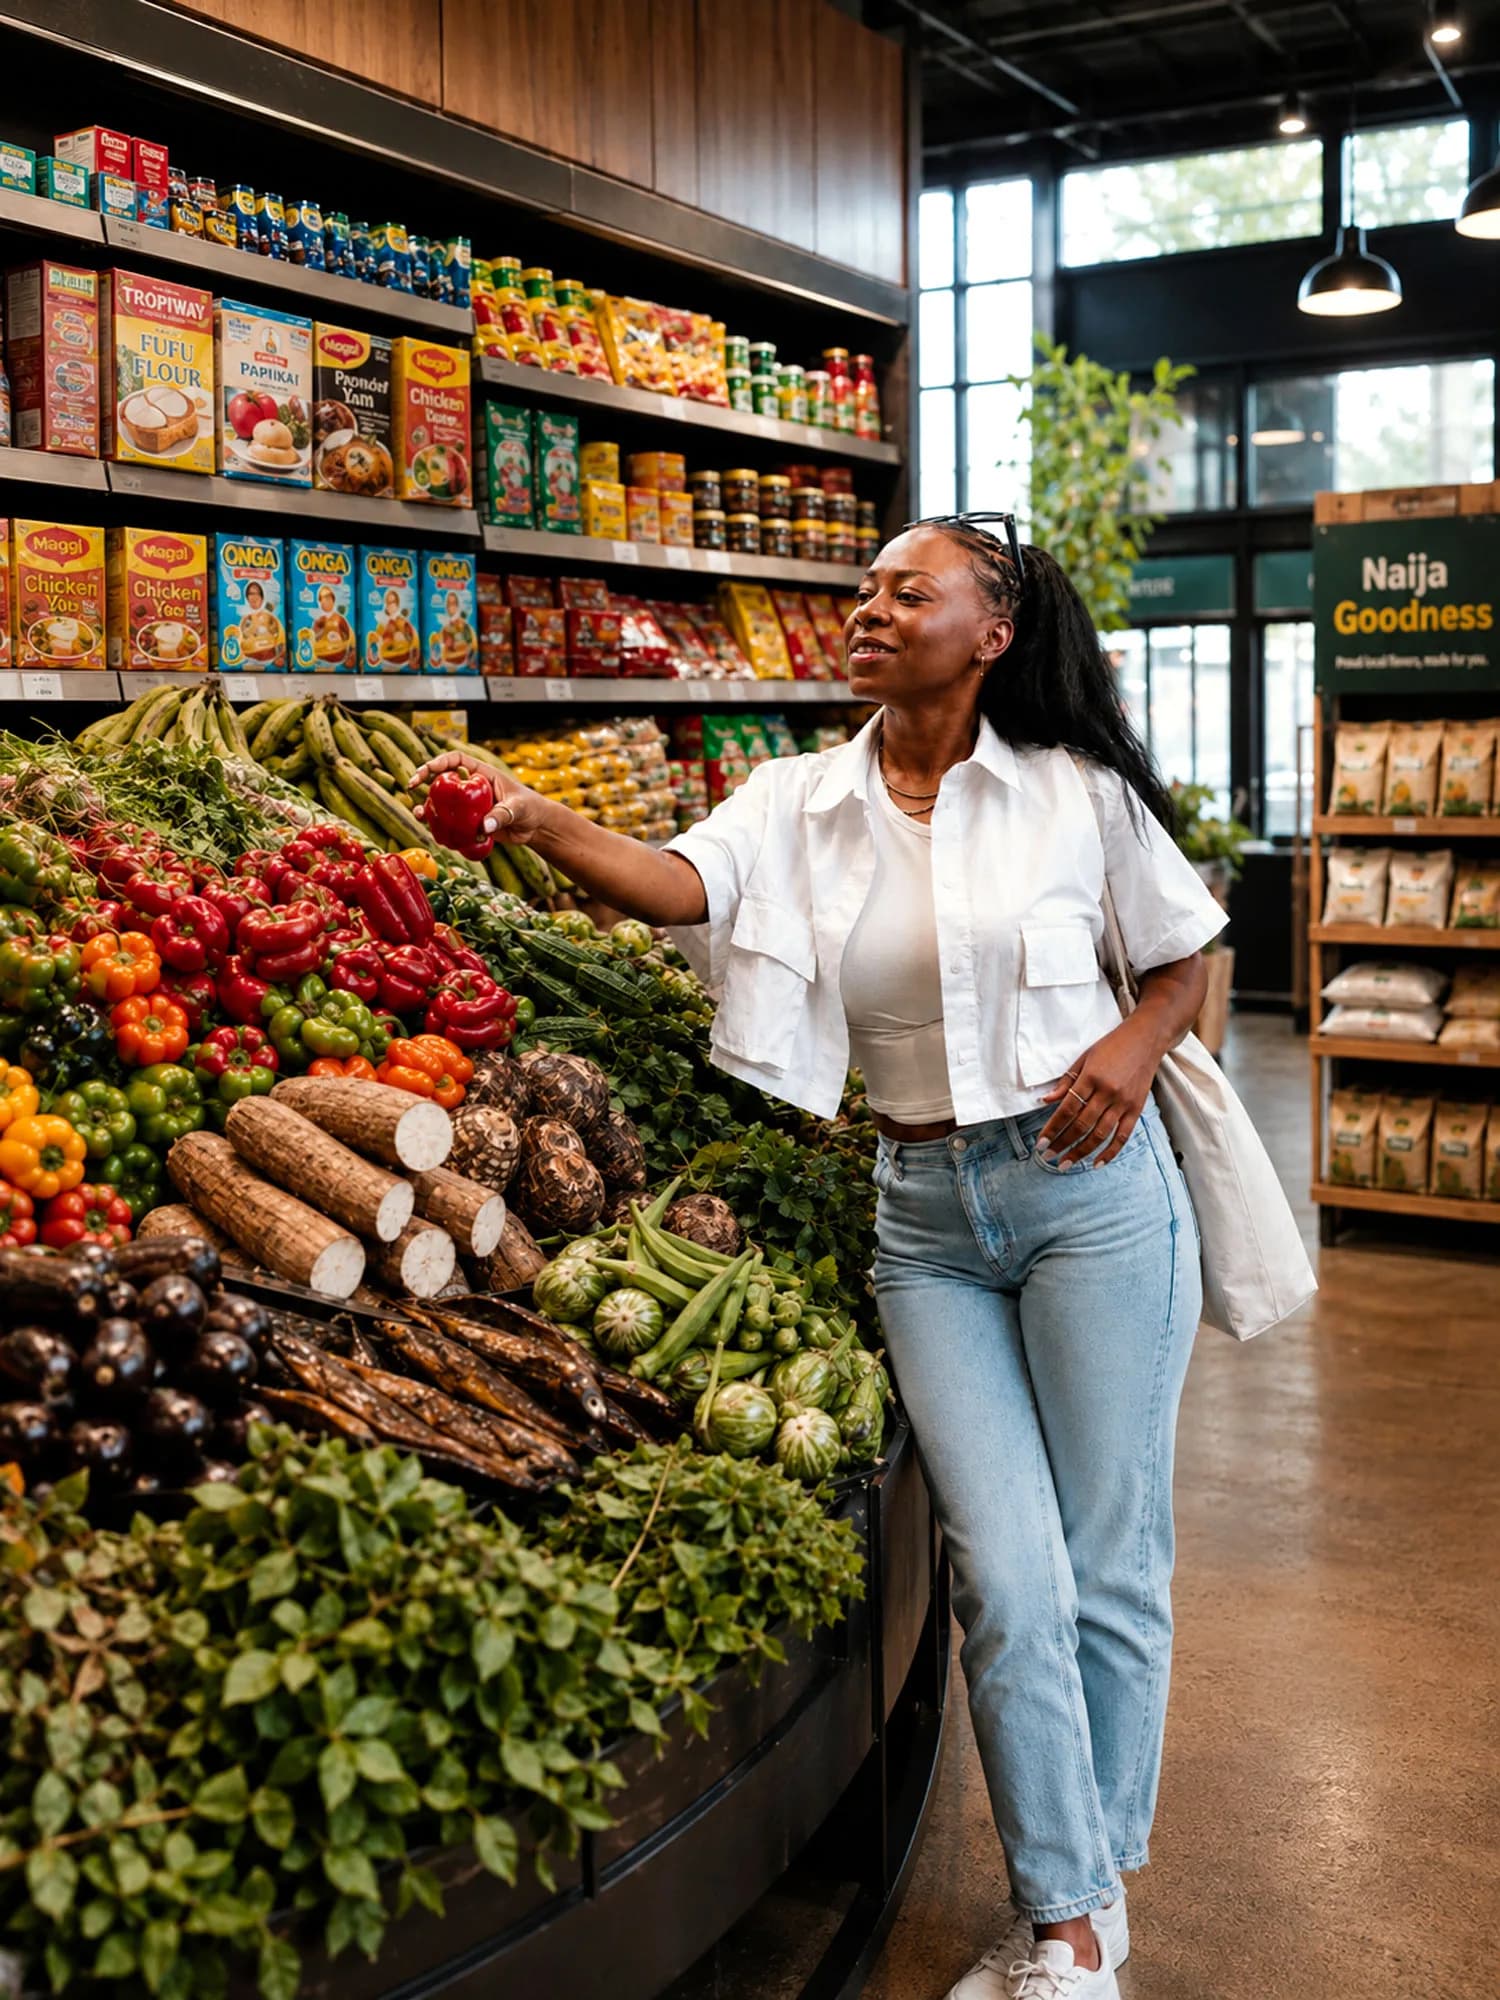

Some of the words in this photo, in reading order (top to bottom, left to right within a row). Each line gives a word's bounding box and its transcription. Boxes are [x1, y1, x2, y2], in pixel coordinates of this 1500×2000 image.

[122, 286, 205, 320] TROPIWAY
[141, 333, 194, 362] FUFU
[133, 357, 201, 388] FLOUR
[410, 387, 465, 412] Chicken
[33, 536, 82, 555] Maggi
[224, 544, 277, 569] ONGA
[298, 550, 347, 574] ONGA
[367, 554, 412, 578] ONGA
[430, 558, 471, 580] ONGA
[25, 574, 97, 597] Chicken
[1362, 552, 1448, 598] Naija
[134, 580, 201, 601] Chicken
[1333, 598, 1493, 635] Goodness
